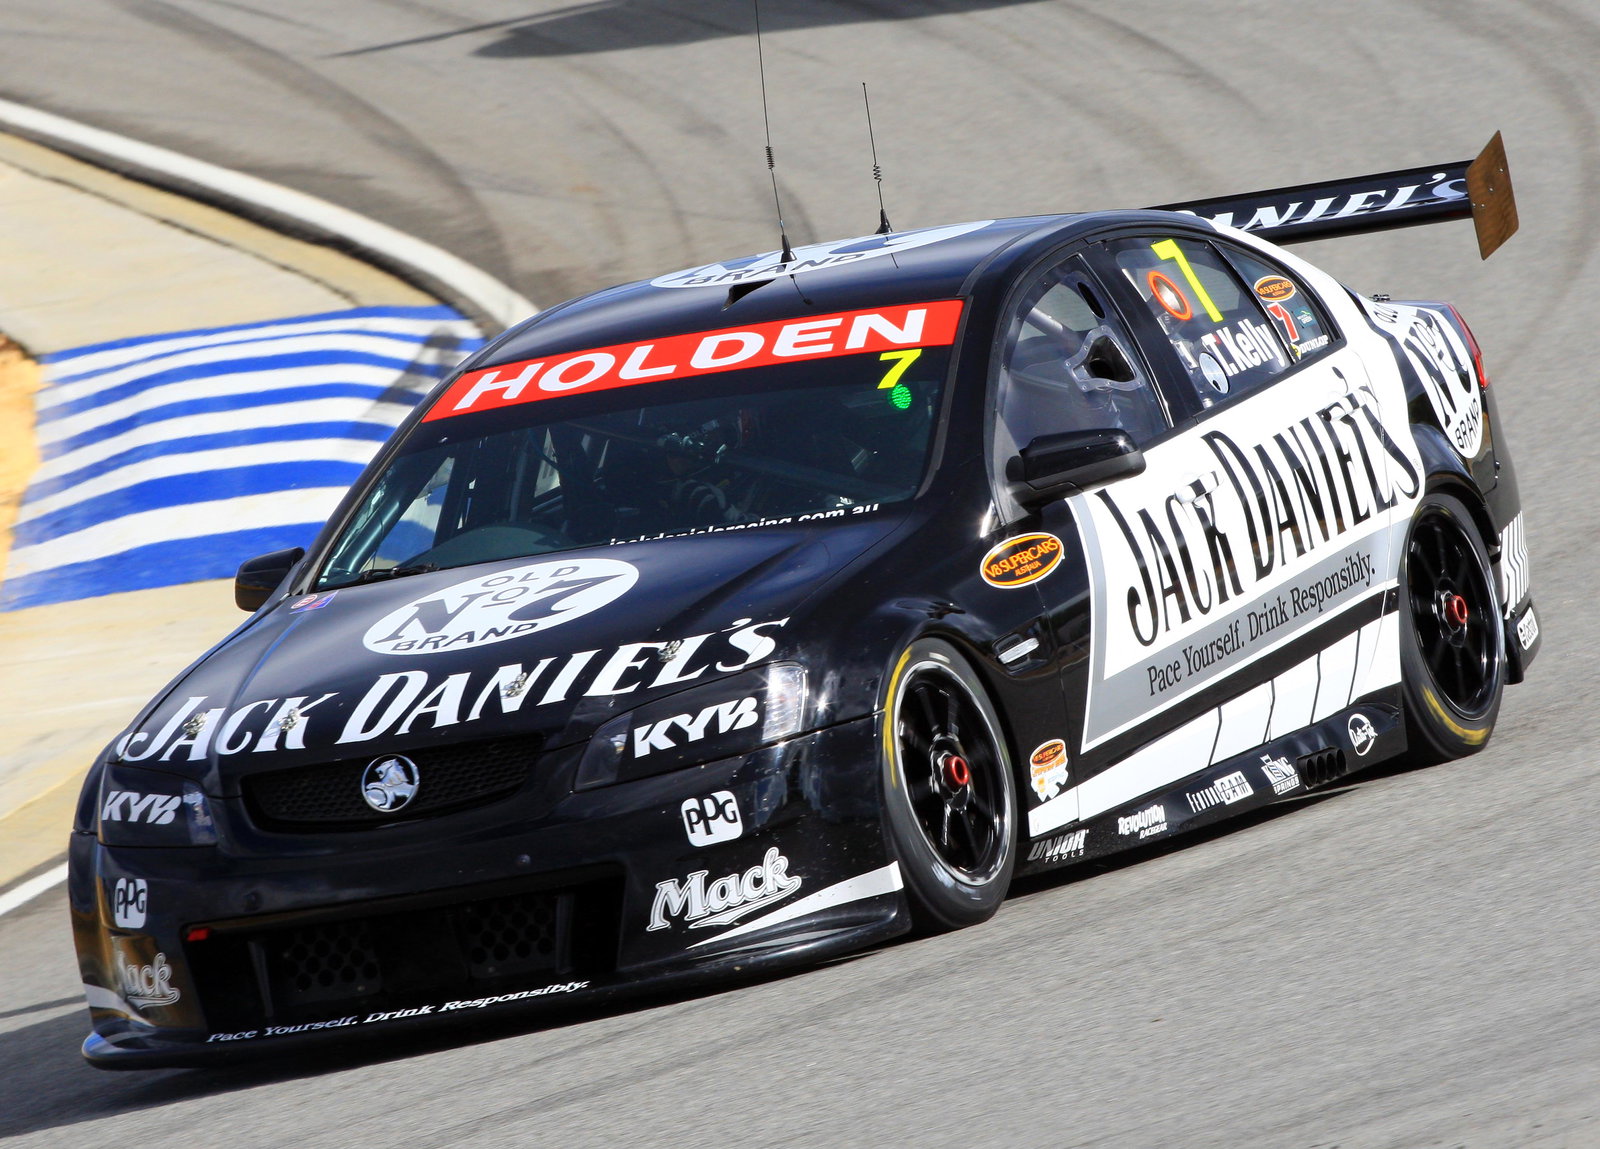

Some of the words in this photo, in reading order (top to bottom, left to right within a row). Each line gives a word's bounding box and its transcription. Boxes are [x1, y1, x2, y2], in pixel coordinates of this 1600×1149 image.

[1150, 238, 1224, 323] 7
[1267, 302, 1300, 342] 7
[452, 309, 927, 411] HOLDEN
[877, 348, 922, 389] 7
[1454, 397, 1480, 449] BRAND
[1094, 470, 1245, 648] JACK
[1200, 366, 1421, 583] DANIEL'S
[481, 565, 580, 588] OLD
[391, 622, 539, 651] BRAND
[1147, 655, 1183, 697] Pace
[1182, 618, 1246, 679] Yourself.
[1247, 597, 1290, 643] Drink
[1290, 550, 1376, 620] Responsibly.
[117, 692, 340, 762] JACK
[334, 617, 790, 745] DANIEL'S
[634, 697, 759, 758] KYB
[1273, 775, 1300, 795] SPRINGS
[102, 790, 181, 825] KYB
[685, 794, 738, 836] PPG
[1118, 804, 1166, 836] REVOLUTION
[1027, 829, 1086, 862] UNIOR
[1139, 822, 1167, 840] RACEGEAR
[1044, 849, 1085, 864] TOOLS
[116, 877, 145, 919] PPG
[646, 846, 802, 931] Mack
[206, 1029, 258, 1043] Pace
[263, 1015, 358, 1037] Yourself.
[362, 1003, 434, 1025] Drink
[437, 980, 591, 1013] Responsibly.
